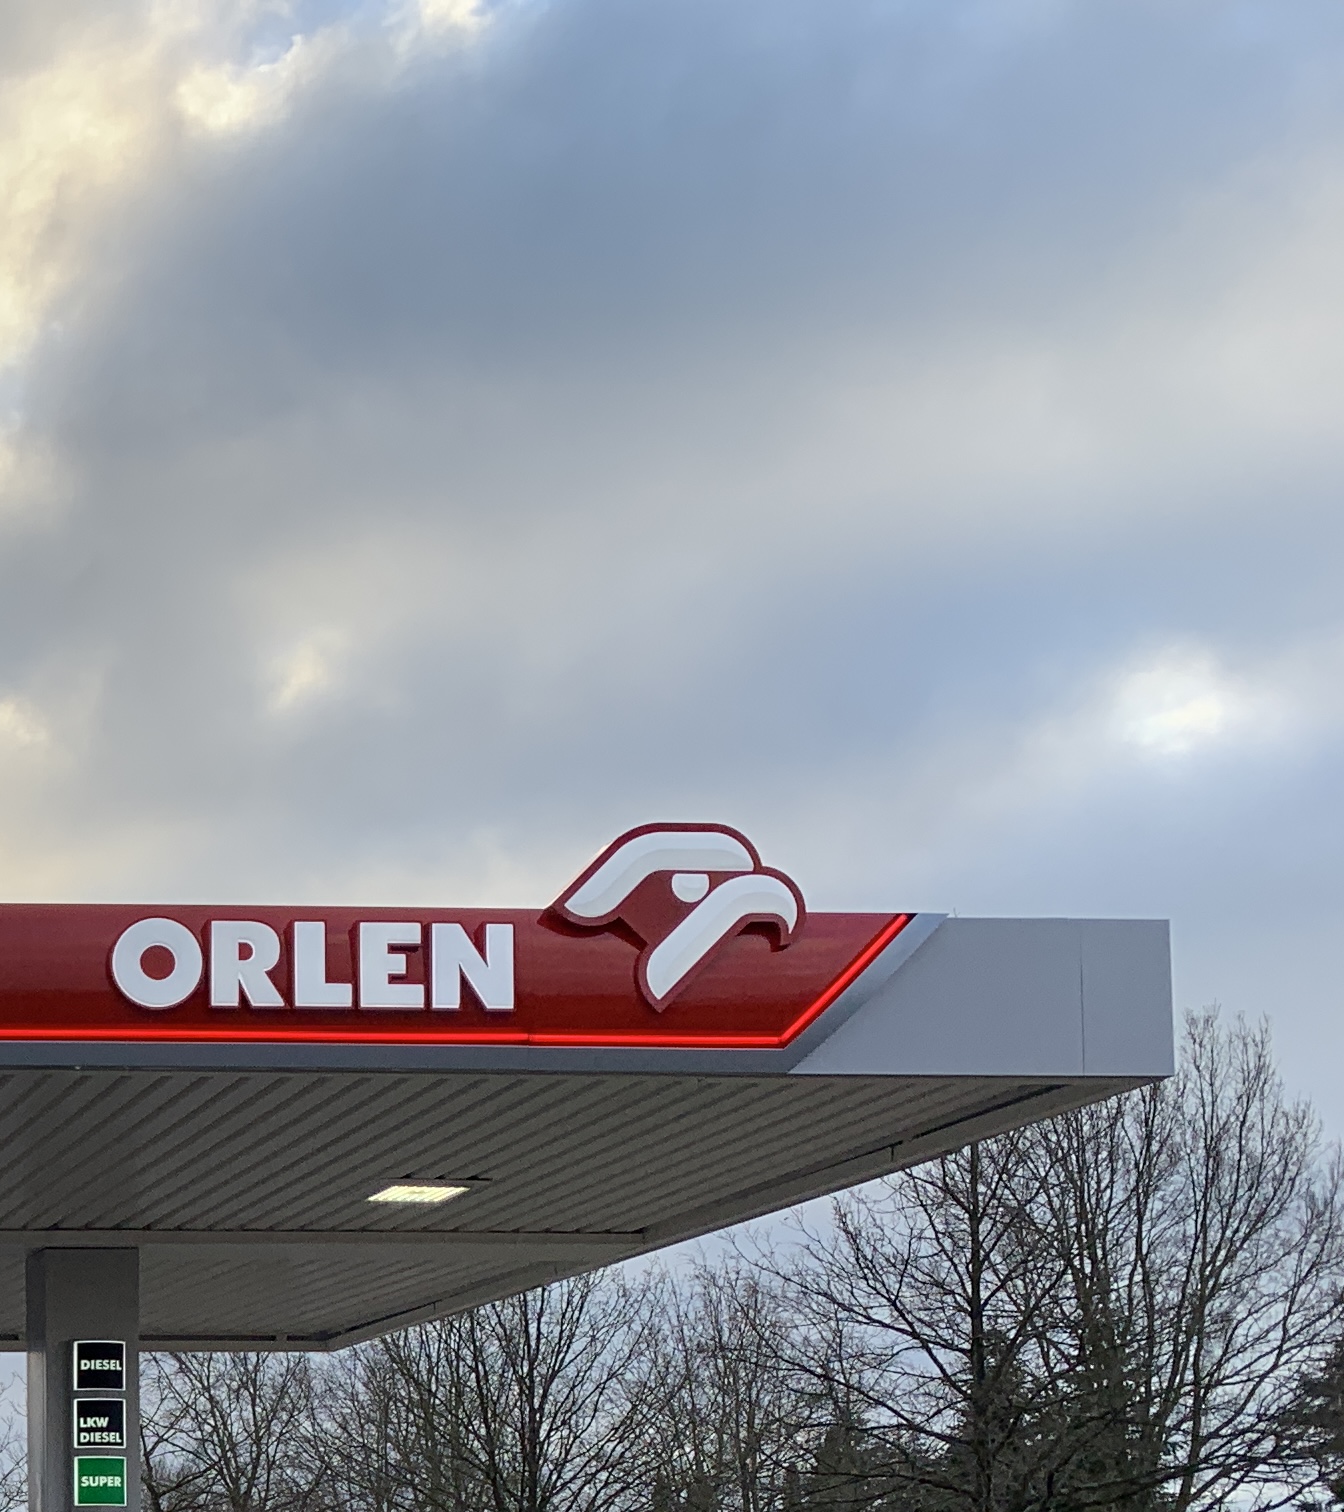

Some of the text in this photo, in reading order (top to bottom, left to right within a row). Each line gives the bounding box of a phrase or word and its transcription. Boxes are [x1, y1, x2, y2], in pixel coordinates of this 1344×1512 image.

[111, 916, 516, 1010] ORLEN
[80, 1360, 122, 1371] DIESEL
[79, 1417, 109, 1428] LKW
[79, 1432, 122, 1443] DIESEL
[80, 1476, 122, 1487] SUPER
